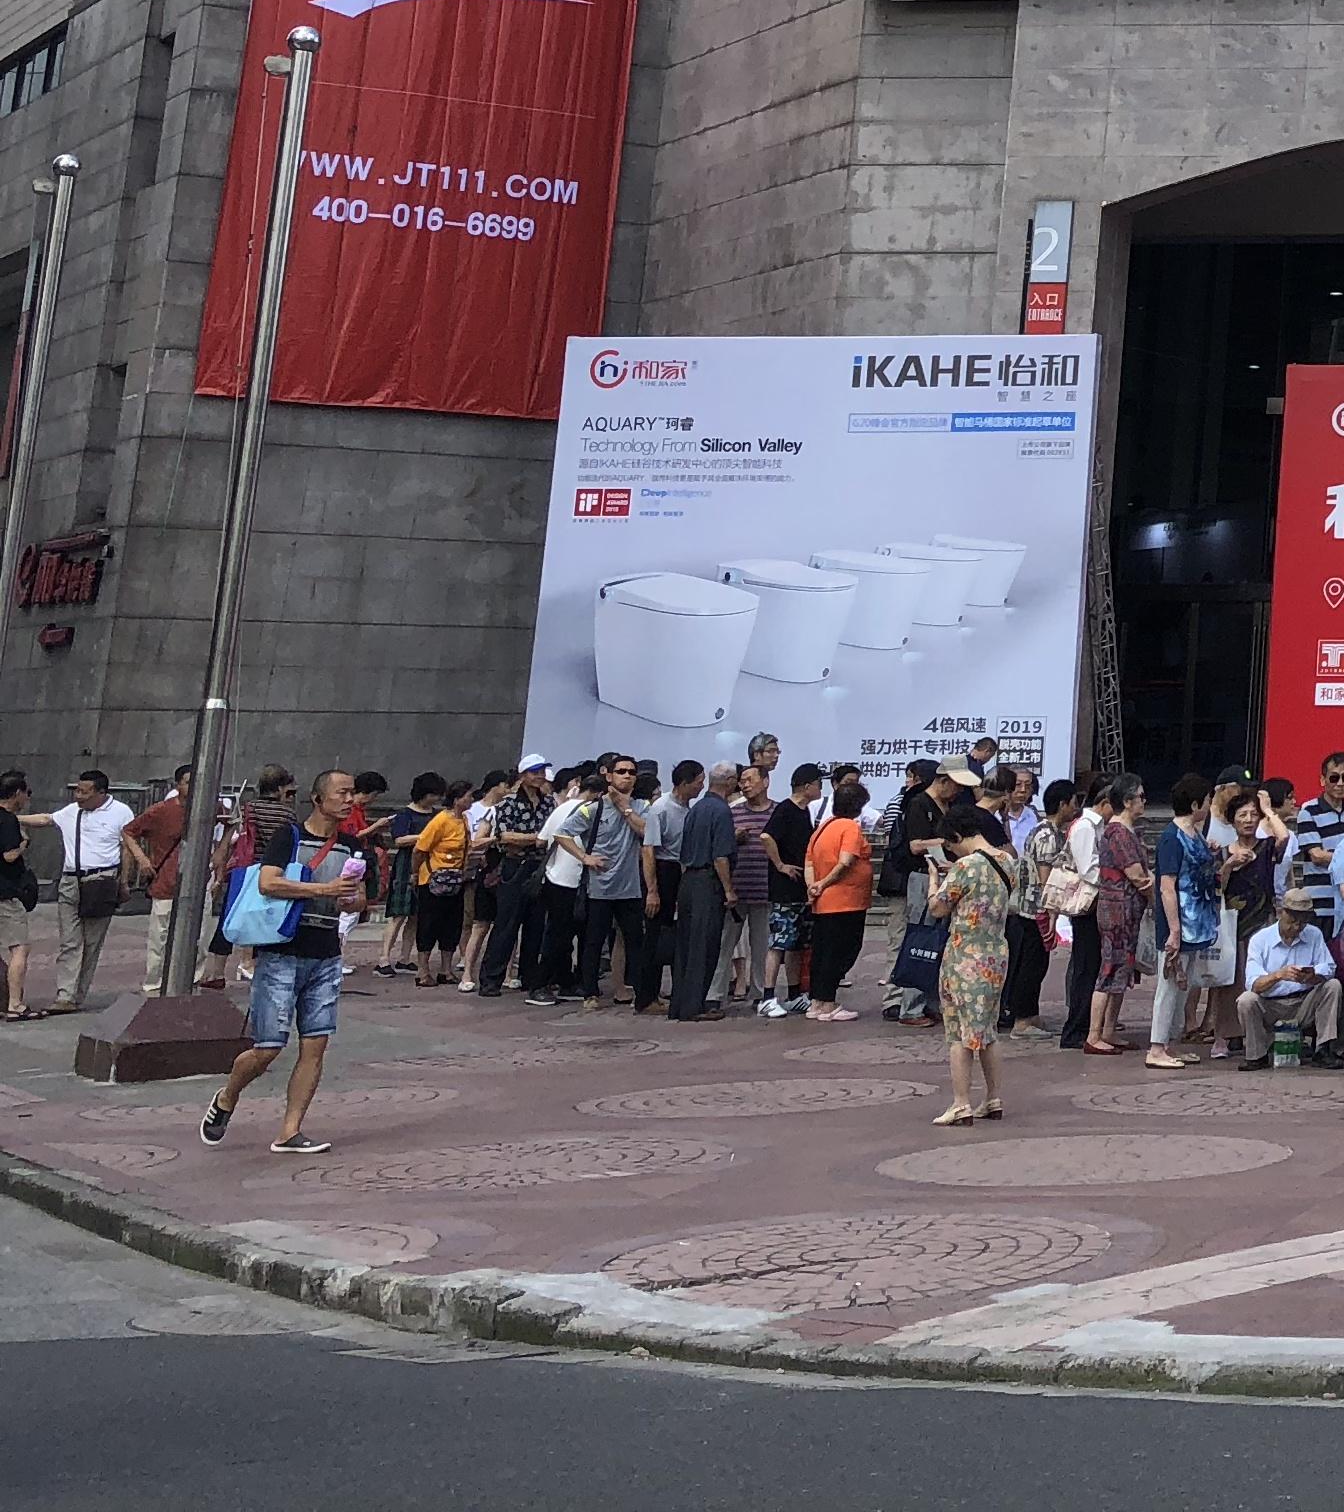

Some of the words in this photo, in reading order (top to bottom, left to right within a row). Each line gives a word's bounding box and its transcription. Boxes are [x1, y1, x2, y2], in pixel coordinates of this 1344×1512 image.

[298, 150, 578, 204] WW.JT111.COM
[313, 196, 535, 240] 400-016-6699
[1030, 293, 1058, 305] 入口
[632, 360, 687, 380] 和家
[852, 355, 992, 388] iKAHE
[998, 354, 1080, 386] 怡和
[997, 391, 1077, 402] 智慧之座
[581, 438, 657, 455] Technology
[662, 438, 697, 452] From
[700, 438, 751, 452] Silicon
[758, 438, 802, 454] Valley
[923, 717, 986, 733] 4倍风速
[1000, 721, 1042, 733] 2019
[861, 739, 976, 755] 强力烘干专利技
[998, 752, 1040, 763] 全新上市
